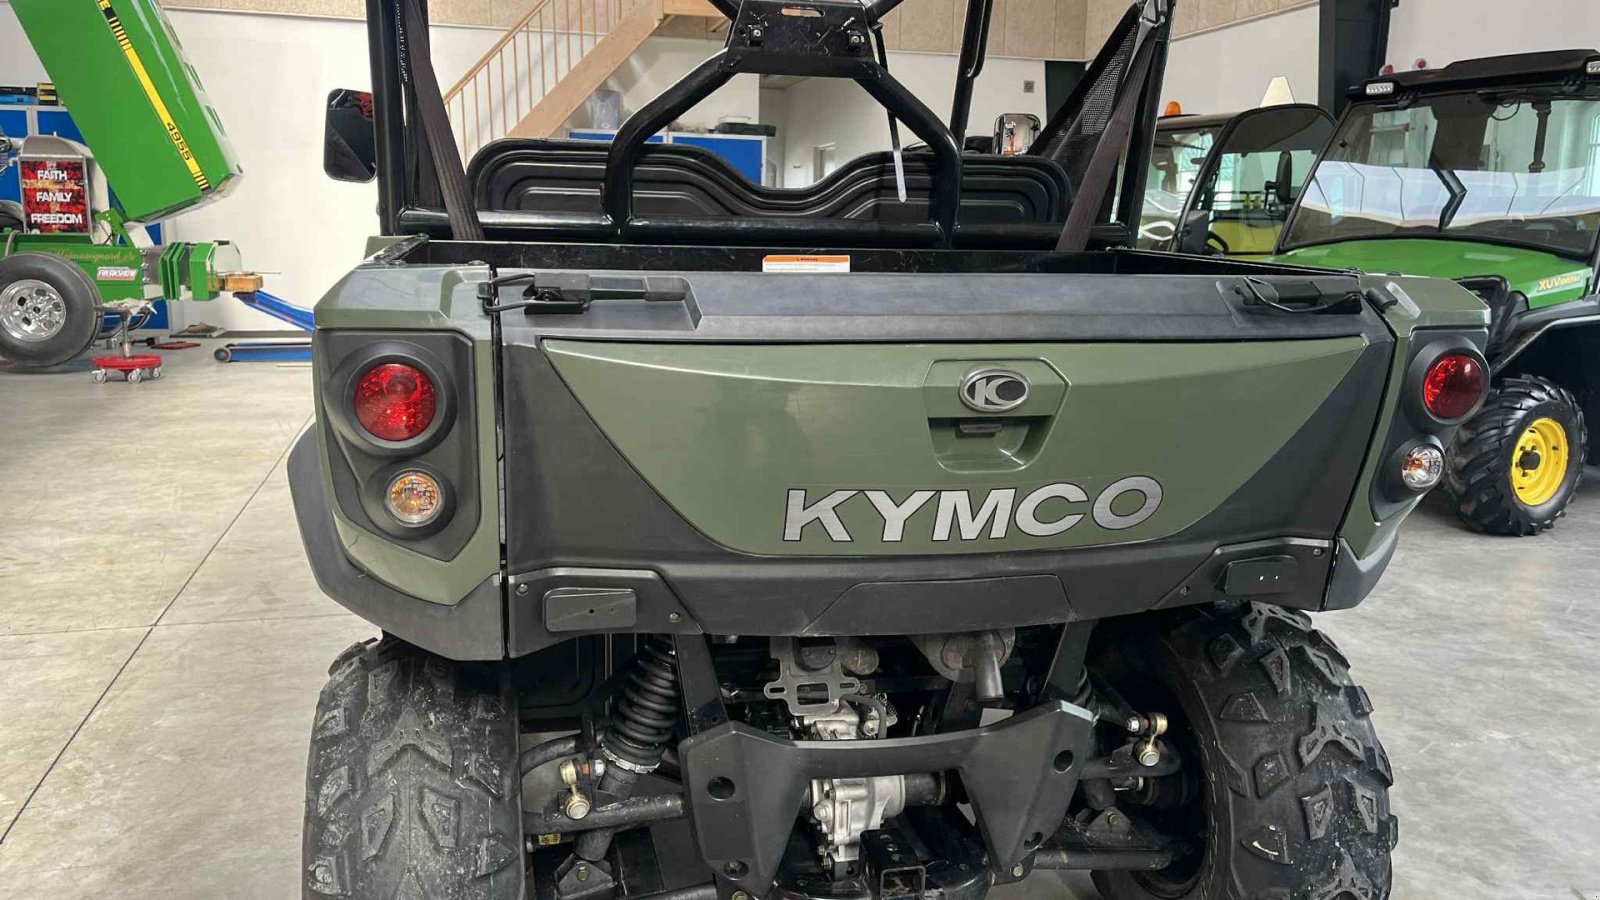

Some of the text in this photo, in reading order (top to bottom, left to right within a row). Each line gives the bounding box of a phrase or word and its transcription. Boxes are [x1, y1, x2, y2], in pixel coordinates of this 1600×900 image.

[167, 122, 192, 160] 4955
[37, 170, 67, 180] FAITH
[36, 192, 72, 203] FAMILY
[31, 213, 83, 224] FREEDOM
[782, 475, 1164, 543] KYMCO
